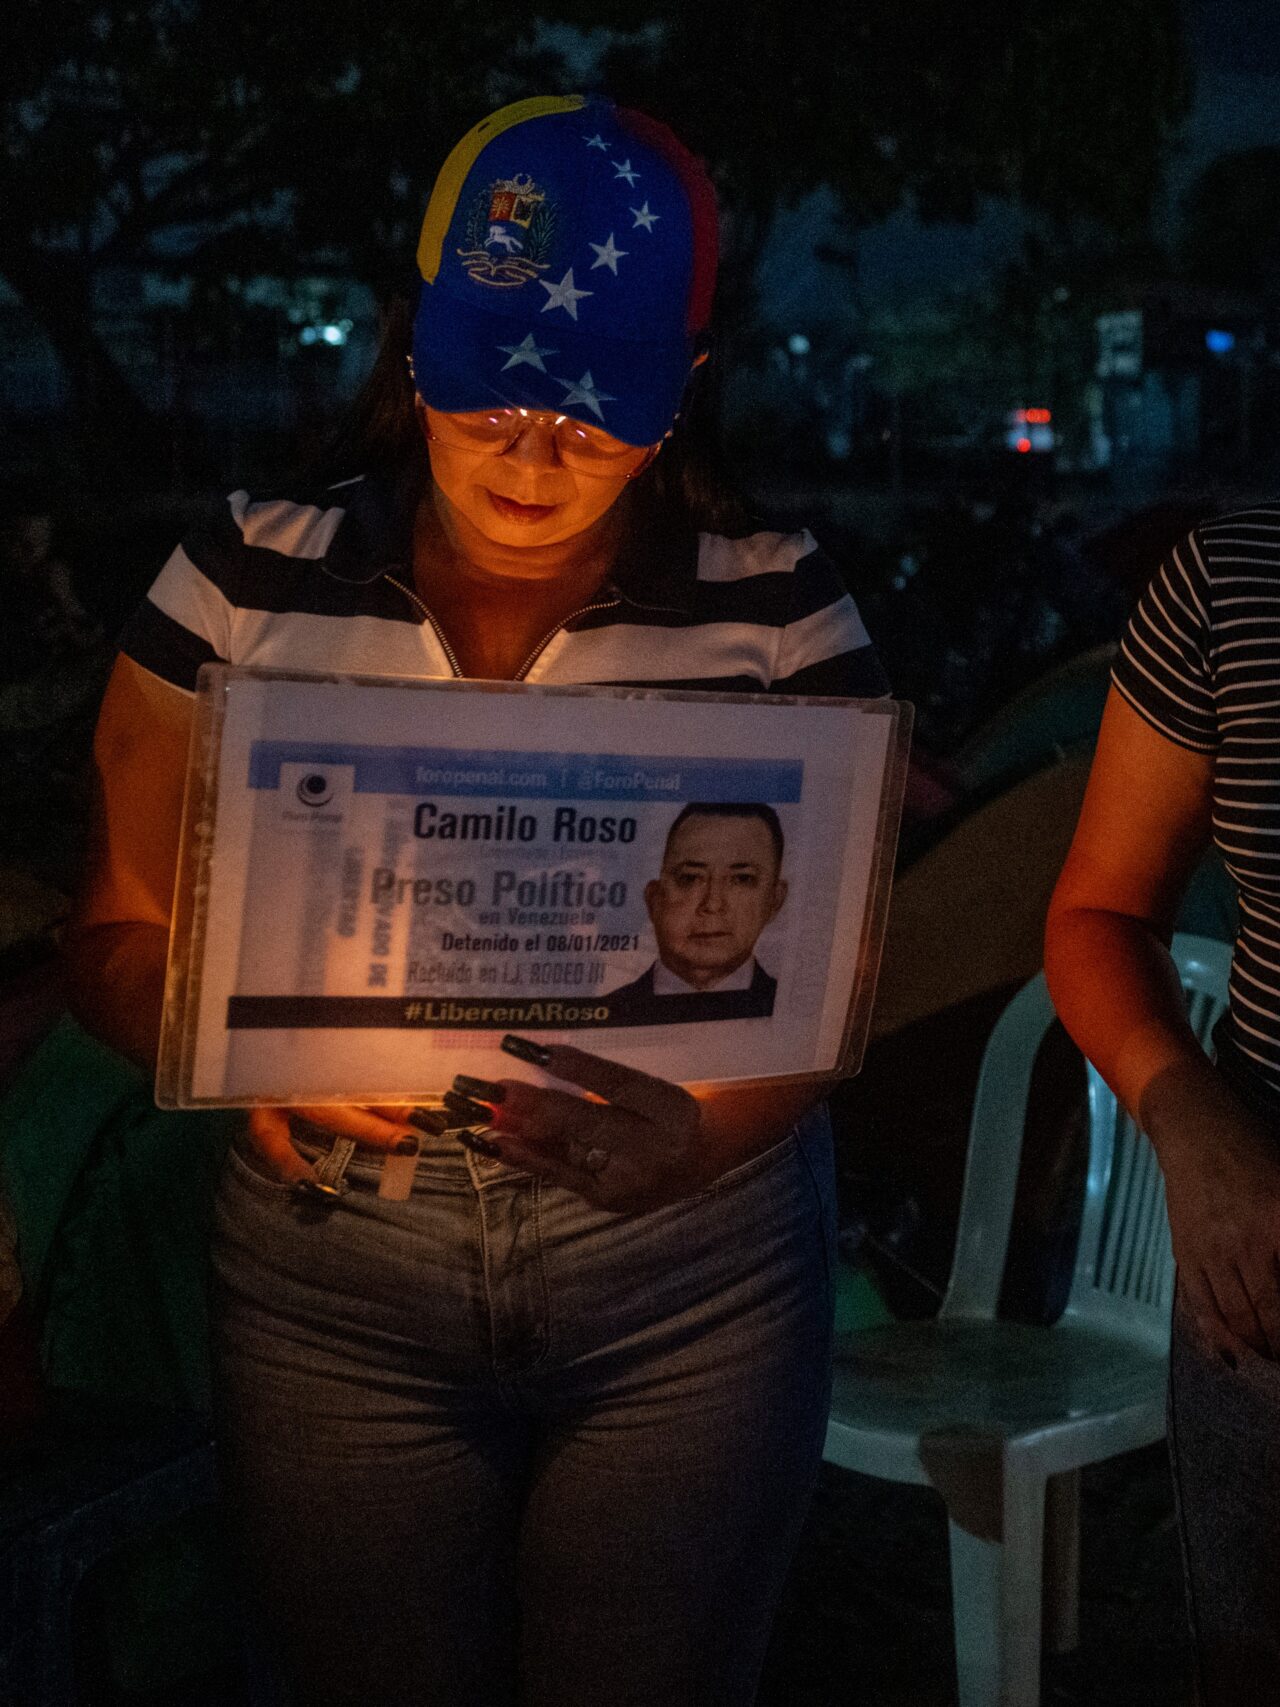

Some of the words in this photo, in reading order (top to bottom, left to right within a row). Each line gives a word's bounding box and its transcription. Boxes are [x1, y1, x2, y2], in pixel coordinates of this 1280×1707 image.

[413, 802, 538, 842] Camilo
[552, 806, 638, 844] Roso
[370, 867, 477, 908] Preso
[491, 869, 629, 909] Político
[478, 911, 499, 926] en
[507, 907, 596, 927] Venezuela
[441, 932, 519, 952] Detenido
[524, 933, 540, 952] el
[546, 933, 640, 953] 08/01/2021
[404, 1001, 610, 1023] #LiberenARoso
